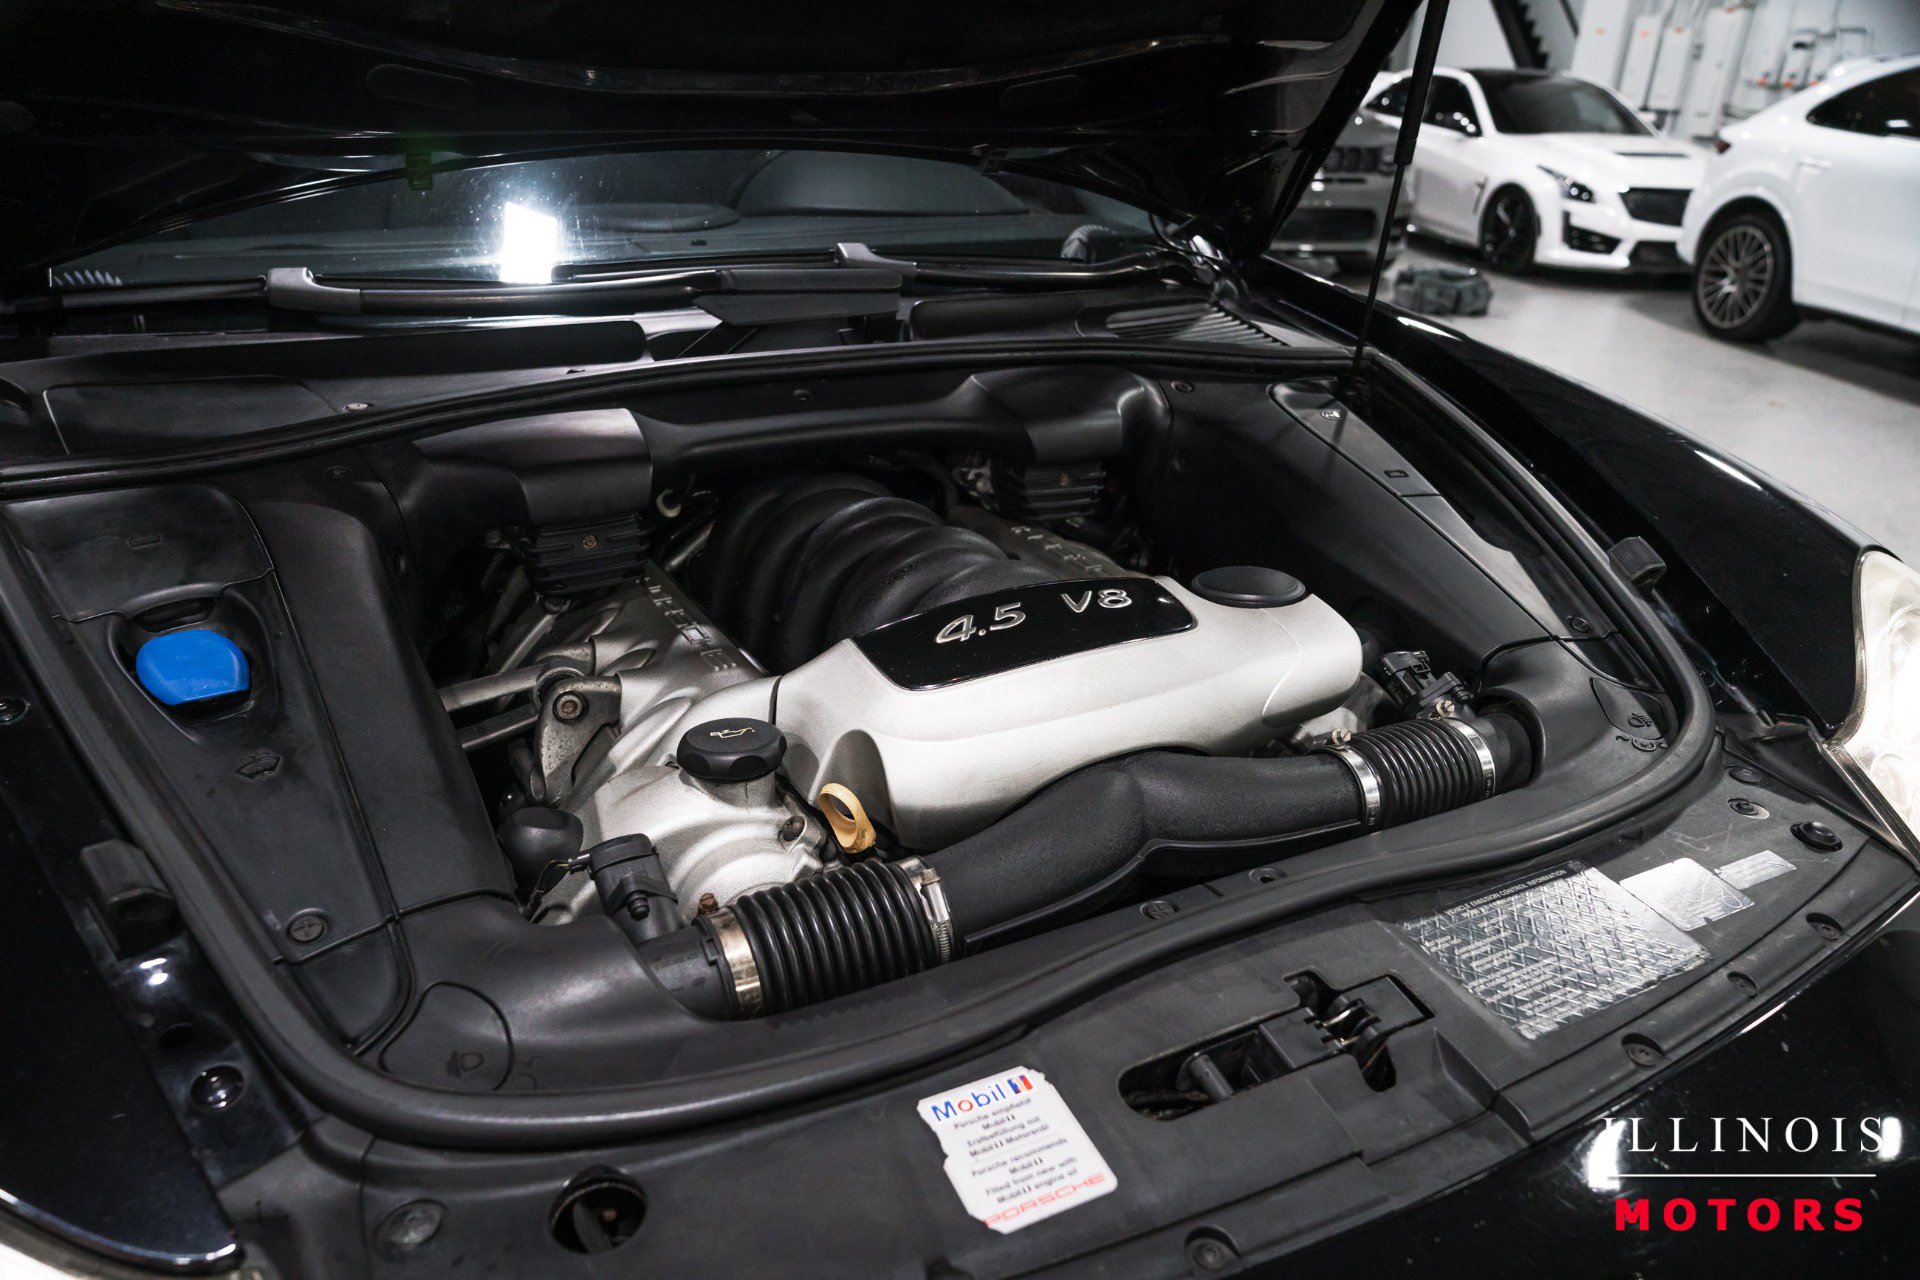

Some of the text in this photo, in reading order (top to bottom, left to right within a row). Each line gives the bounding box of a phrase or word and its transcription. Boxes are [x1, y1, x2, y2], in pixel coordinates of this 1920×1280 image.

[934, 588, 1132, 644] 4.5 V8
[1444, 902, 1472, 916] VEHICLE
[1469, 892, 1501, 909] EMISSION
[1499, 883, 1528, 898] CONTROL
[1526, 869, 1567, 887] INFORMATION
[931, 1084, 1007, 1122] Mobil
[953, 1112, 989, 1130] Porsche
[971, 1159, 1008, 1177] Porsche
[982, 1172, 1106, 1228] PORSCHE
